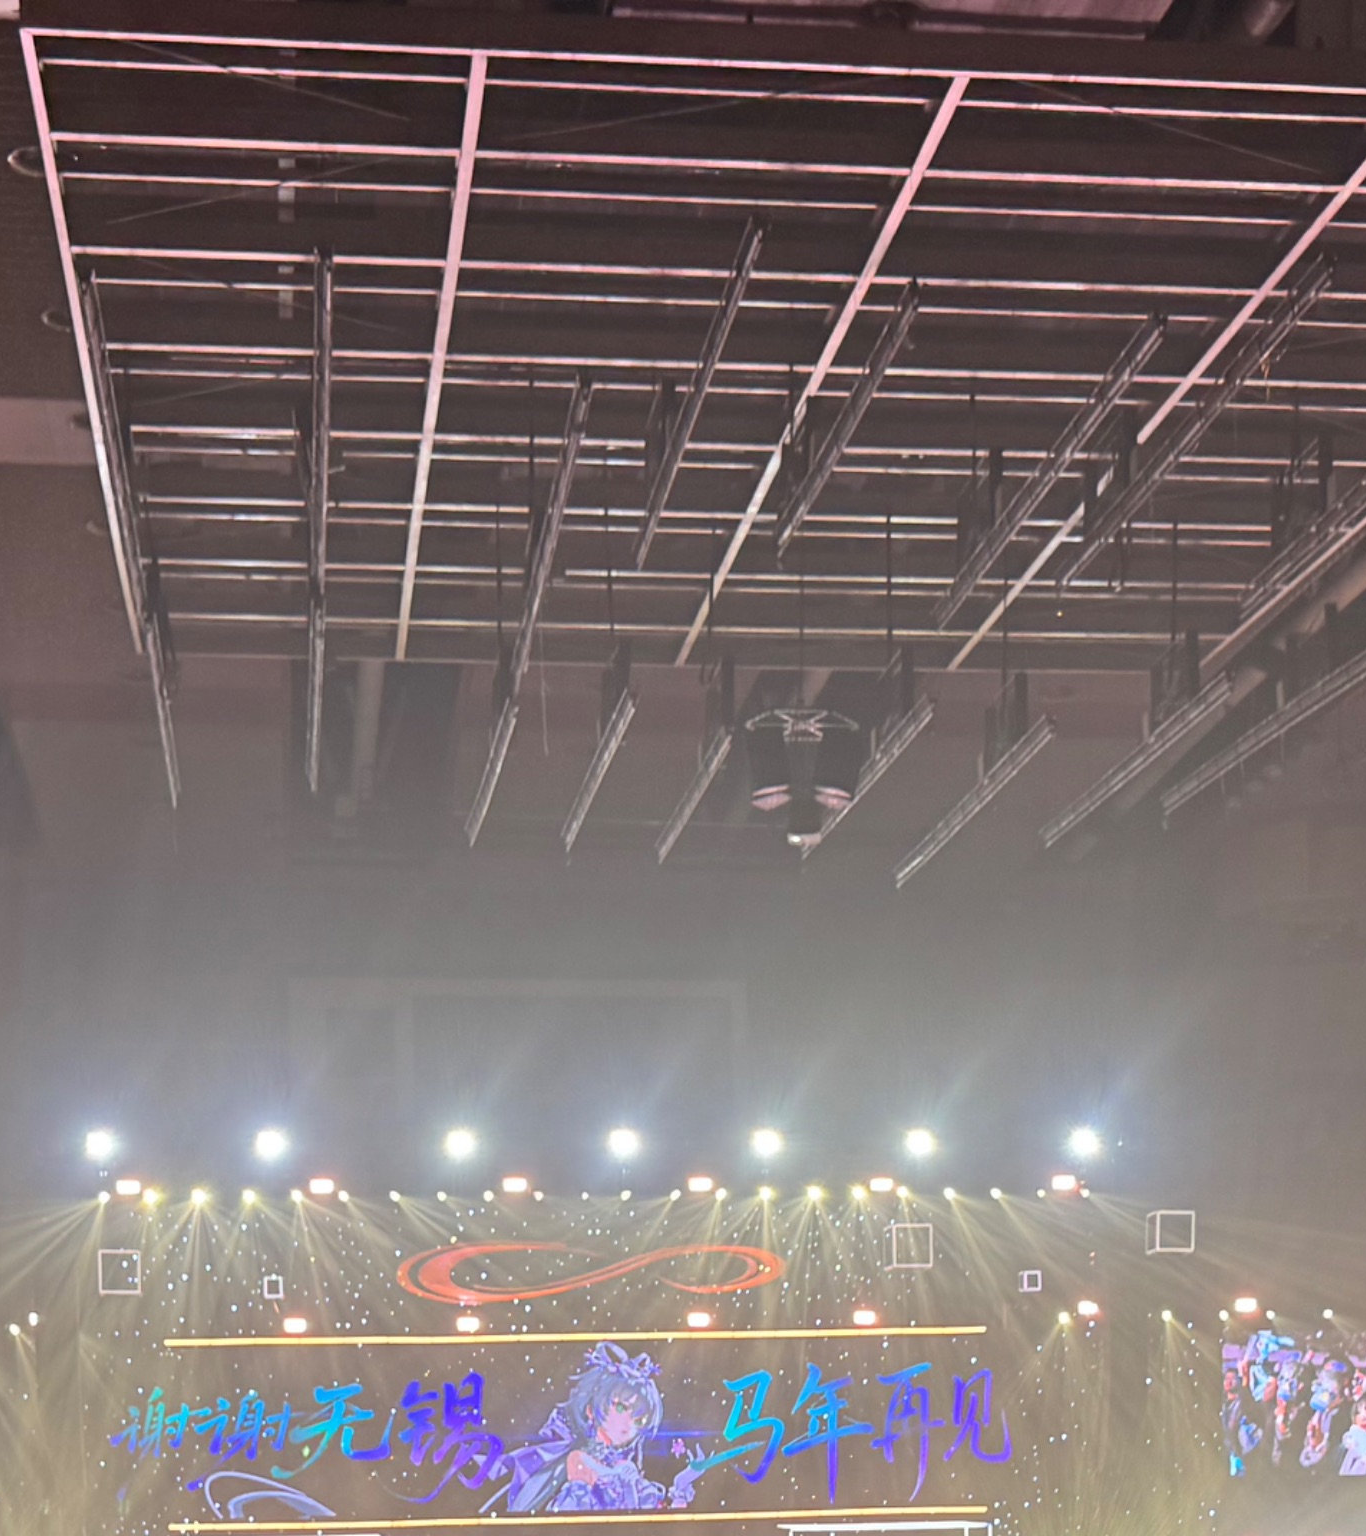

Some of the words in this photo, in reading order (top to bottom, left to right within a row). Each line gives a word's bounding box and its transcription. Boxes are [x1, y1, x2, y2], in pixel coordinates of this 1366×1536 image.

[109, 1370, 507, 1503] 谢谢无锡
[691, 1362, 1013, 1504] 马年再见
